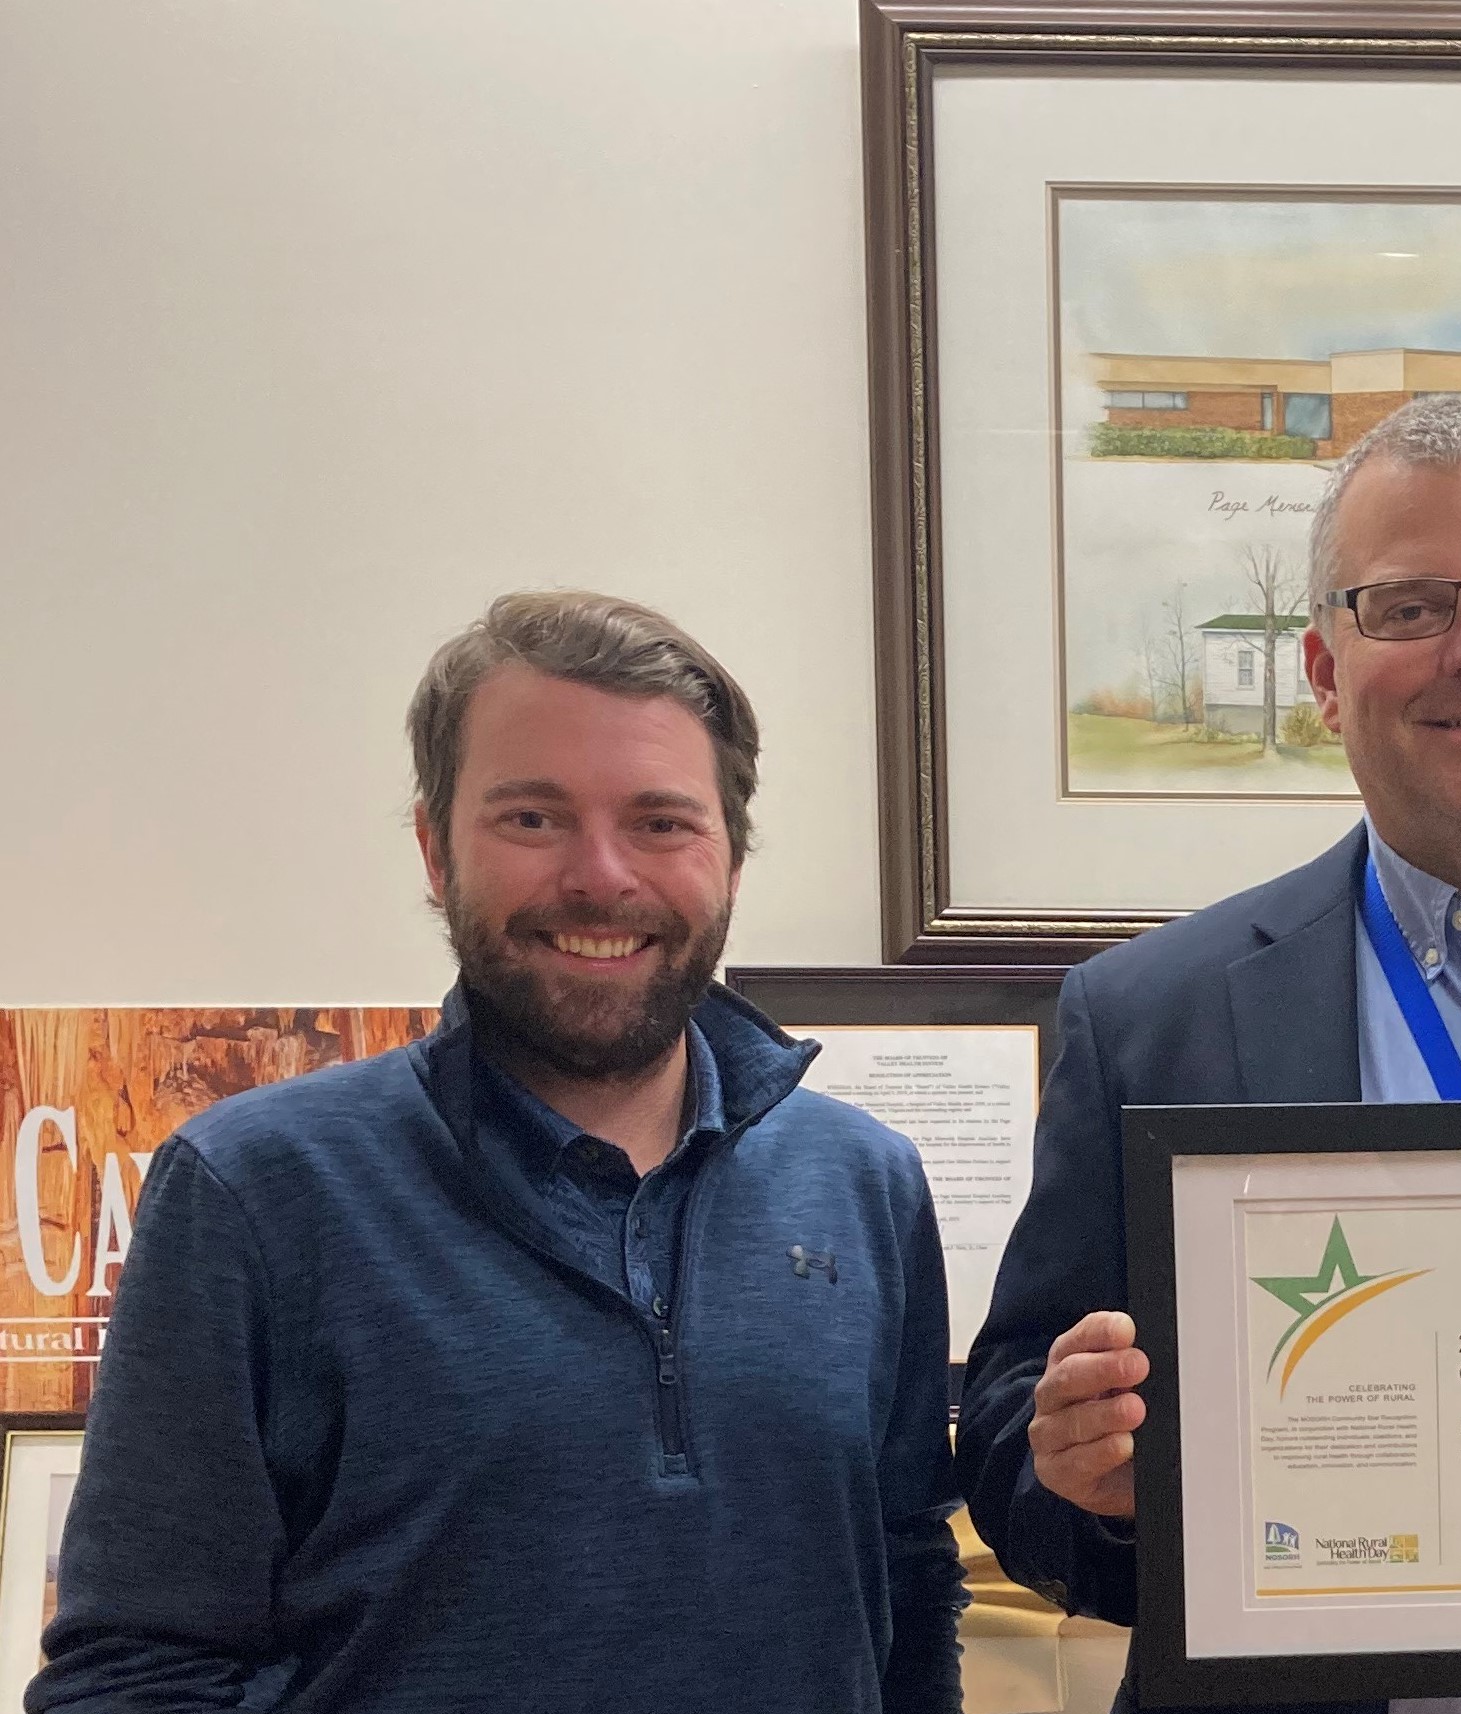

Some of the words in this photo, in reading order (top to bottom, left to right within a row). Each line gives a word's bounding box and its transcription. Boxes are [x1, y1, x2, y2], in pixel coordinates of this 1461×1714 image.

[1207, 491, 1249, 521] Page
[1349, 1383, 1416, 1392] CELEBRATING
[1306, 1396, 1325, 1404] THE
[1328, 1394, 1363, 1403] POWER
[1367, 1394, 1380, 1402] OF
[1383, 1393, 1416, 1402] RURAL
[1315, 1538, 1357, 1549] National
[1358, 1537, 1388, 1551] Rural
[1330, 1547, 1368, 1560] Health
[1368, 1547, 1391, 1561] Day
